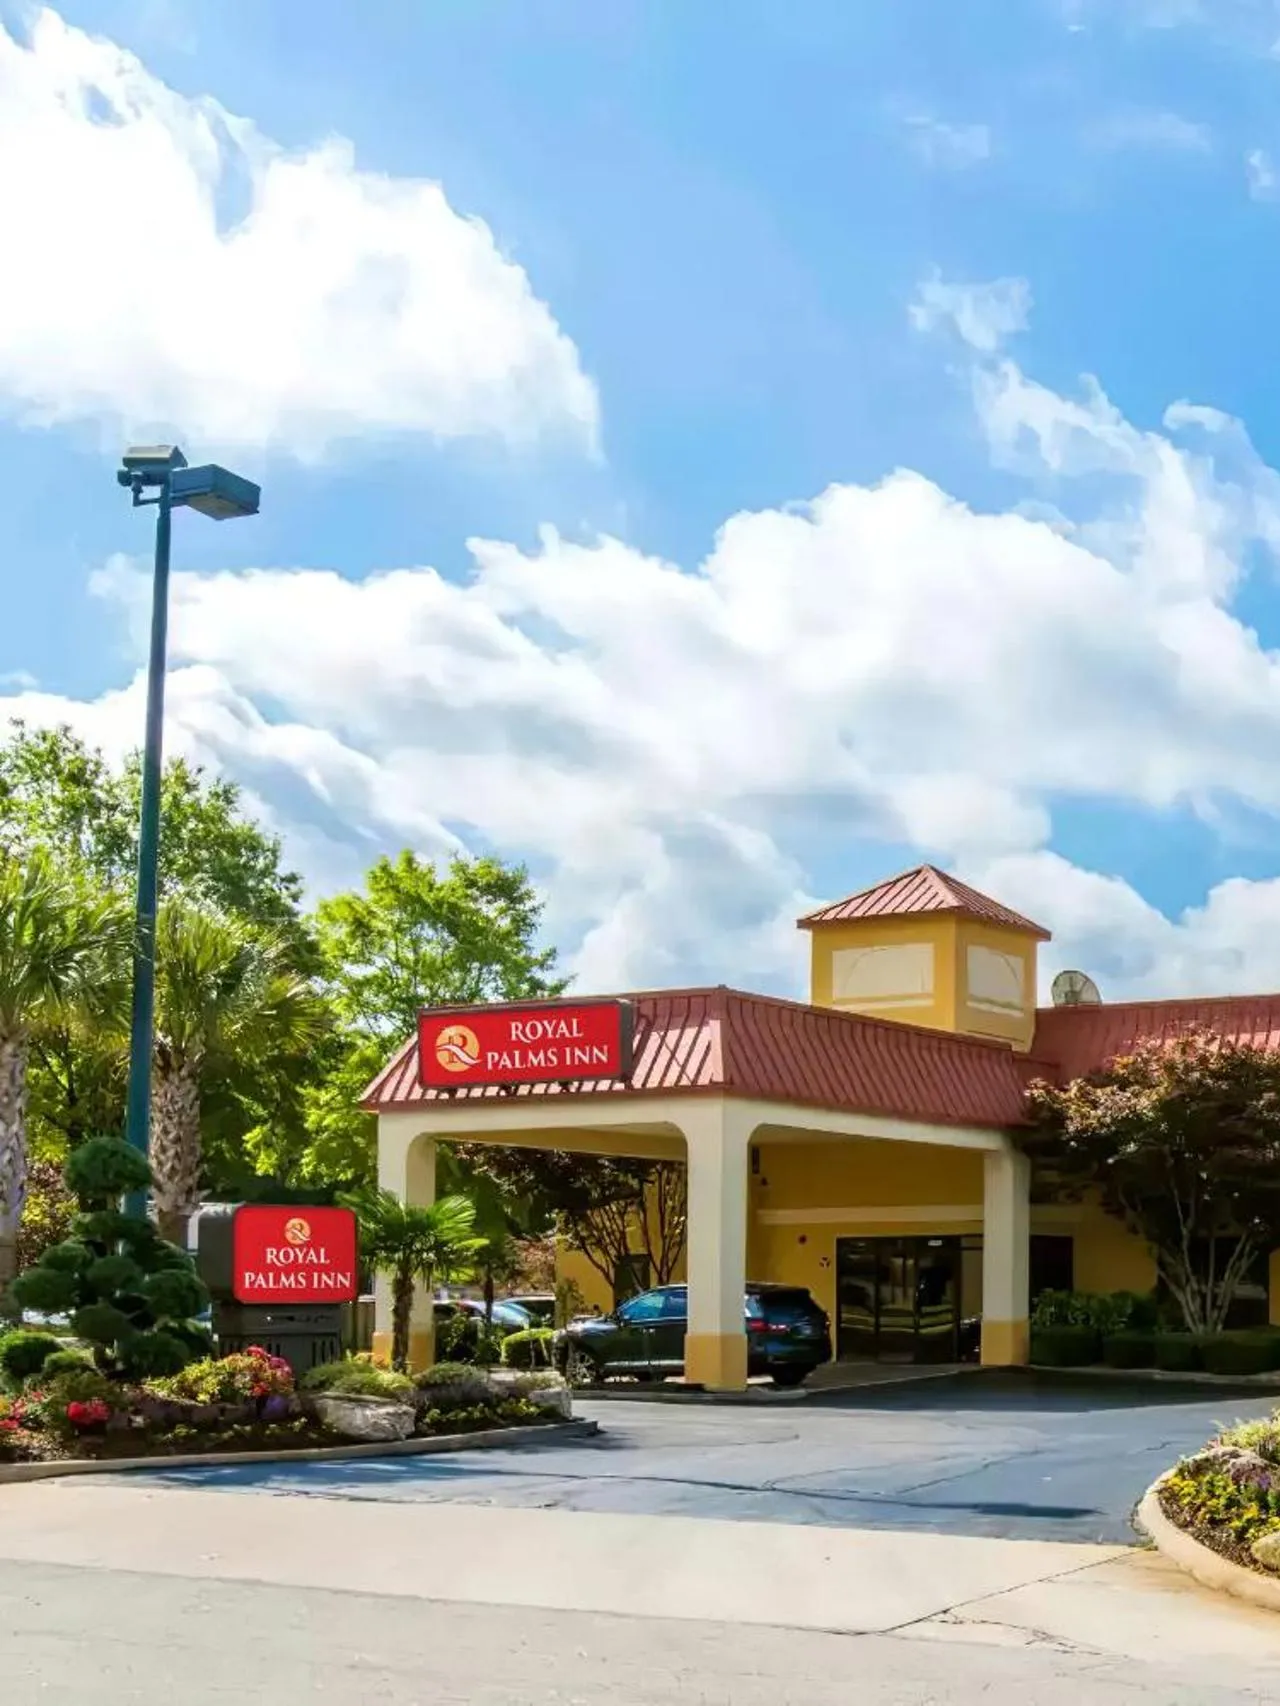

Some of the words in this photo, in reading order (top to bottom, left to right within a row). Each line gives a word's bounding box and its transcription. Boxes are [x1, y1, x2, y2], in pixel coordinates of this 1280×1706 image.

[511, 1018, 584, 1043] ROYAL
[486, 1047, 558, 1070] PALMS
[565, 1045, 608, 1066] INN
[266, 1247, 330, 1267] ROYAL
[244, 1272, 306, 1289] PALMS
[313, 1272, 351, 1289] INN
